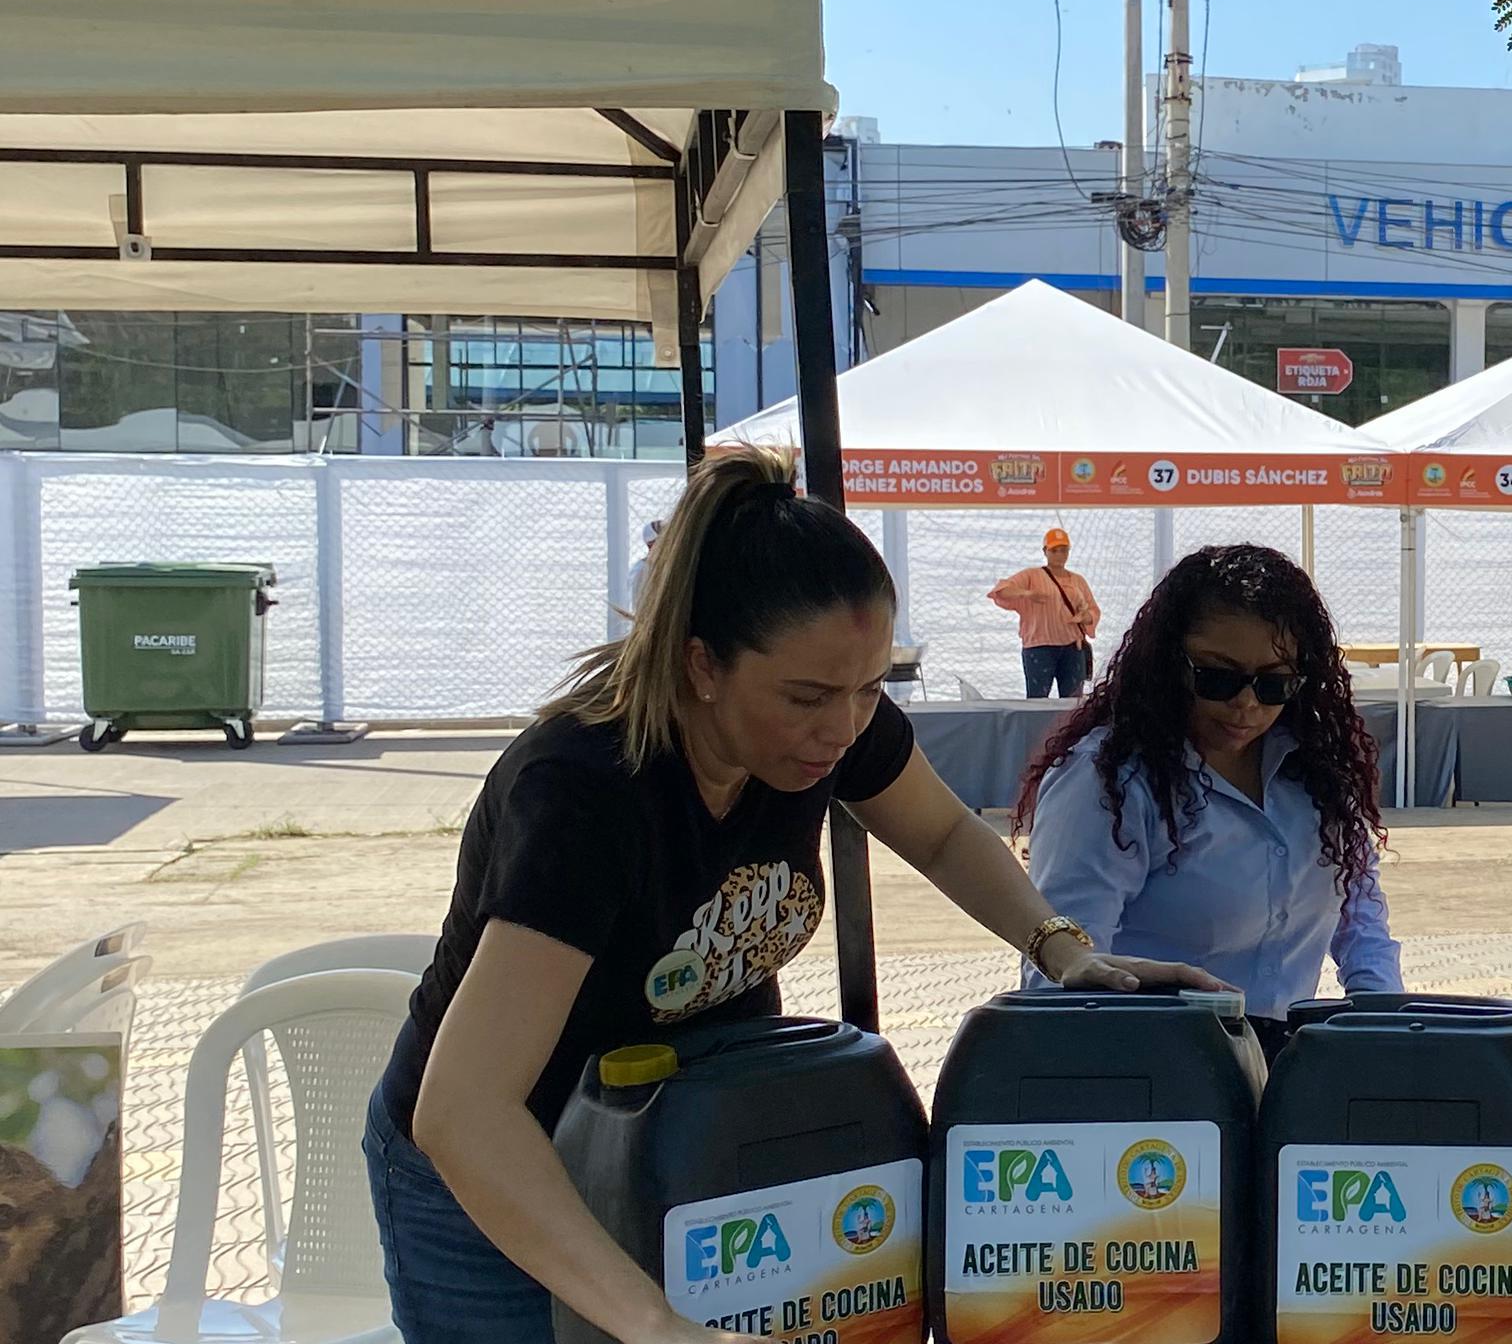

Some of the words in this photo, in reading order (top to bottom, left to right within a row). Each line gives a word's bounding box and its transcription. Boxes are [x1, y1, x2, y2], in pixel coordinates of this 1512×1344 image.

[1285, 365, 1340, 376] ETIQUETA
[1298, 377, 1327, 387] ROJA
[842, 460, 884, 475] ORGE
[889, 460, 978, 475] ARMANDO
[1153, 468, 1174, 484] 37
[1187, 470, 1240, 485] DUBIS
[1245, 465, 1328, 485] SÁNCHEZ
[844, 474, 897, 494] MÉNEZ
[901, 478, 983, 494] MORELOS
[134, 635, 196, 646] PACARIBE
[673, 860, 791, 960] Keep
[654, 965, 698, 997] EPA
[963, 1149, 1073, 1203] EPA
[965, 1204, 1074, 1215] CARTAGENA
[1297, 1170, 1407, 1222] EPA
[1298, 1223, 1407, 1235] CARTAGENA
[686, 1213, 792, 1282] EPA
[962, 1242, 1054, 1276] ACEITE
[1063, 1241, 1097, 1275] DE
[1106, 1240, 1199, 1274] COCINA
[688, 1264, 792, 1295] CARTAGENA
[1295, 1262, 1387, 1295] ACEITE
[1396, 1262, 1428, 1296] DE
[782, 1296, 813, 1330] DE
[821, 1276, 908, 1322] COCINA
[1038, 1280, 1124, 1313] USADO
[1370, 1302, 1457, 1335] USADO
